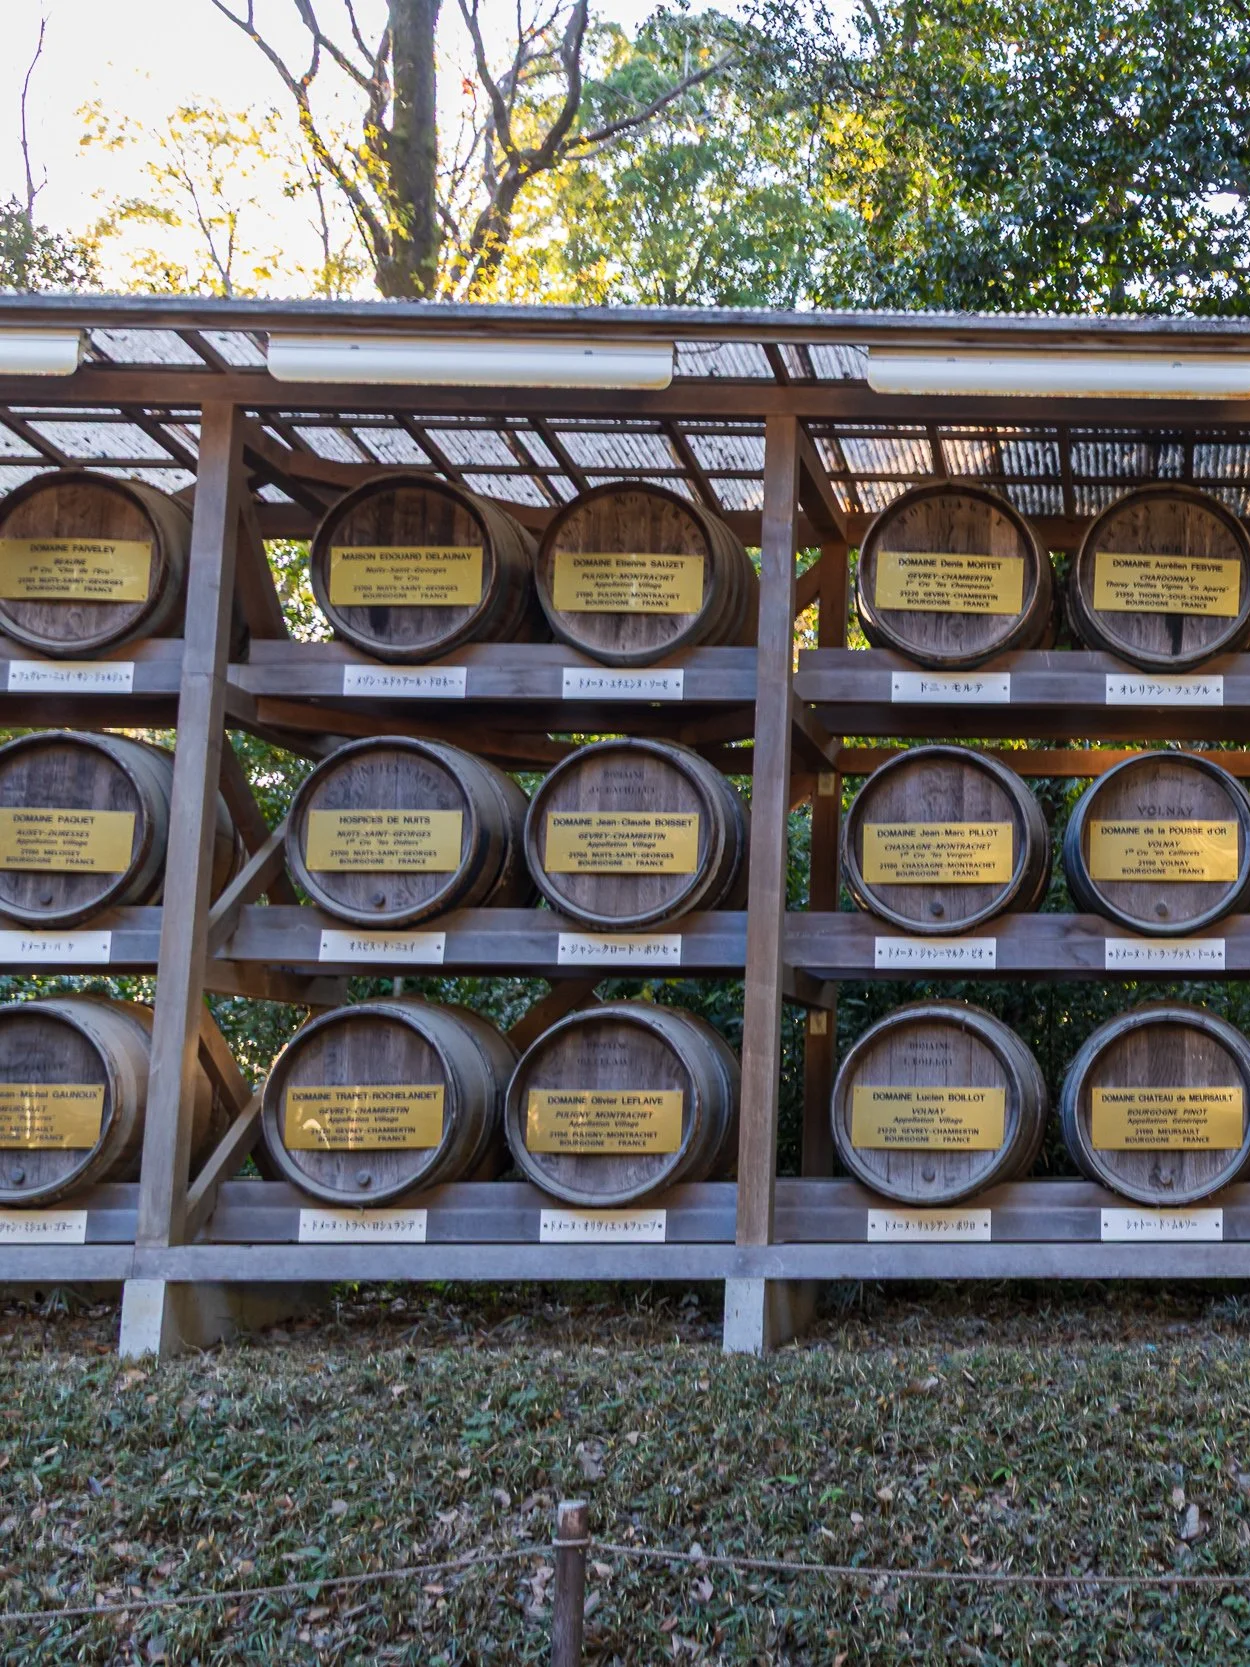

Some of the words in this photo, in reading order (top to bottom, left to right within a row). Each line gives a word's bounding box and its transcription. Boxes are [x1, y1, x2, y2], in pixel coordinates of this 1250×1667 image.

[573, 559, 612, 568] DOMAINE
[898, 558, 937, 568] DOMAINE
[967, 560, 1002, 570] MORTET
[1112, 559, 1151, 569] DOMAINE
[1139, 574, 1195, 583] CHARDONNAY
[920, 682, 984, 693] ドニ・モルテ
[1137, 803, 1194, 817] VOLNAY
[13, 813, 53, 823] DOMAINE
[57, 815, 95, 825] PAQUET
[339, 815, 383, 825] HOSPICES
[387, 816, 399, 825] DE
[403, 816, 431, 825] NUITS
[553, 817, 592, 827] DOMAINE
[877, 829, 916, 838] DOMAINE
[969, 828, 998, 837] PILLOT
[1100, 826, 1140, 835] DOMAINE
[1143, 826, 1154, 835] de
[1158, 826, 1165, 835] la
[292, 1092, 331, 1101] DOMAINE
[547, 1096, 587, 1106] DOMAINE
[872, 1092, 912, 1102] DOMAINE
[916, 1093, 944, 1102] Lucien
[1101, 1094, 1136, 1103] DOMAINE
[1138, 1094, 1173, 1103] CHATEAU
[1176, 1094, 1186, 1103] de
